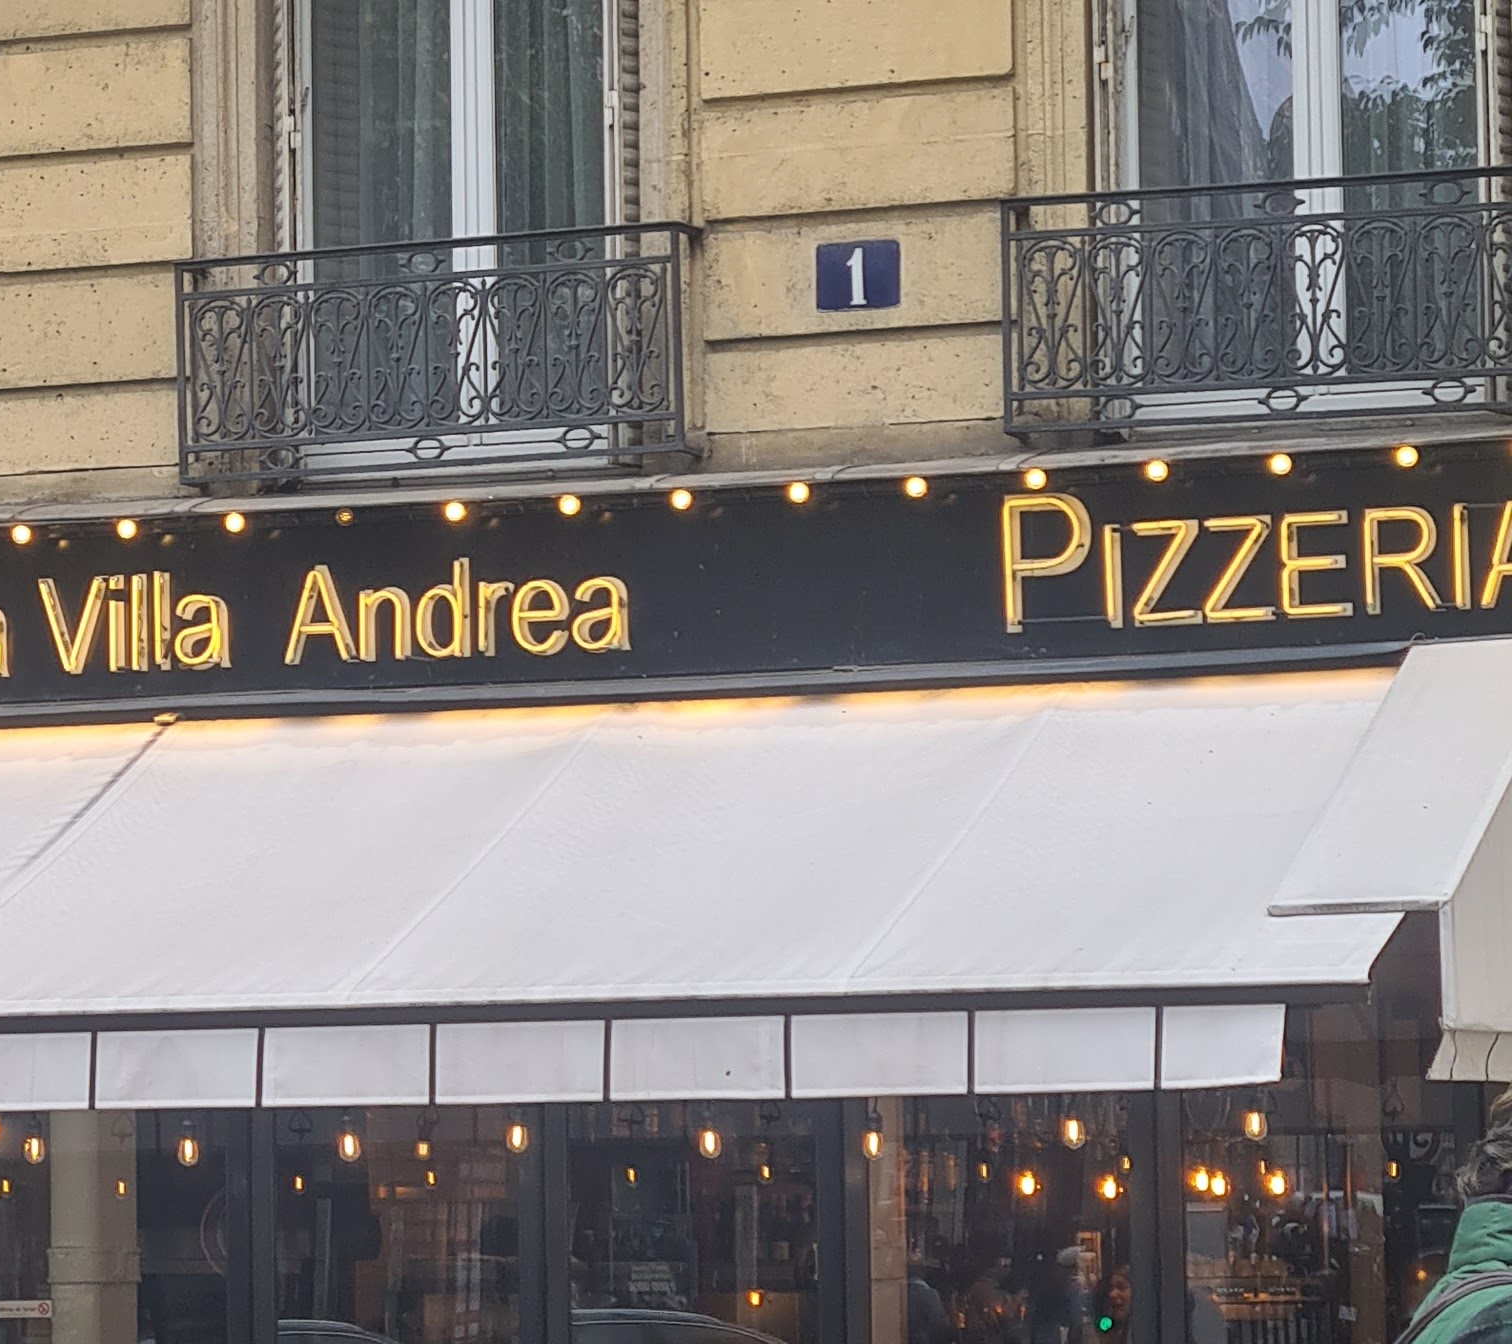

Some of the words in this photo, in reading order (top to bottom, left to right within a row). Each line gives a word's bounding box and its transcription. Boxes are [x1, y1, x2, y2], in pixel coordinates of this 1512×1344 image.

[846, 247, 869, 308] 1
[37, 571, 232, 675] Villa
[283, 556, 632, 666] Andrea
